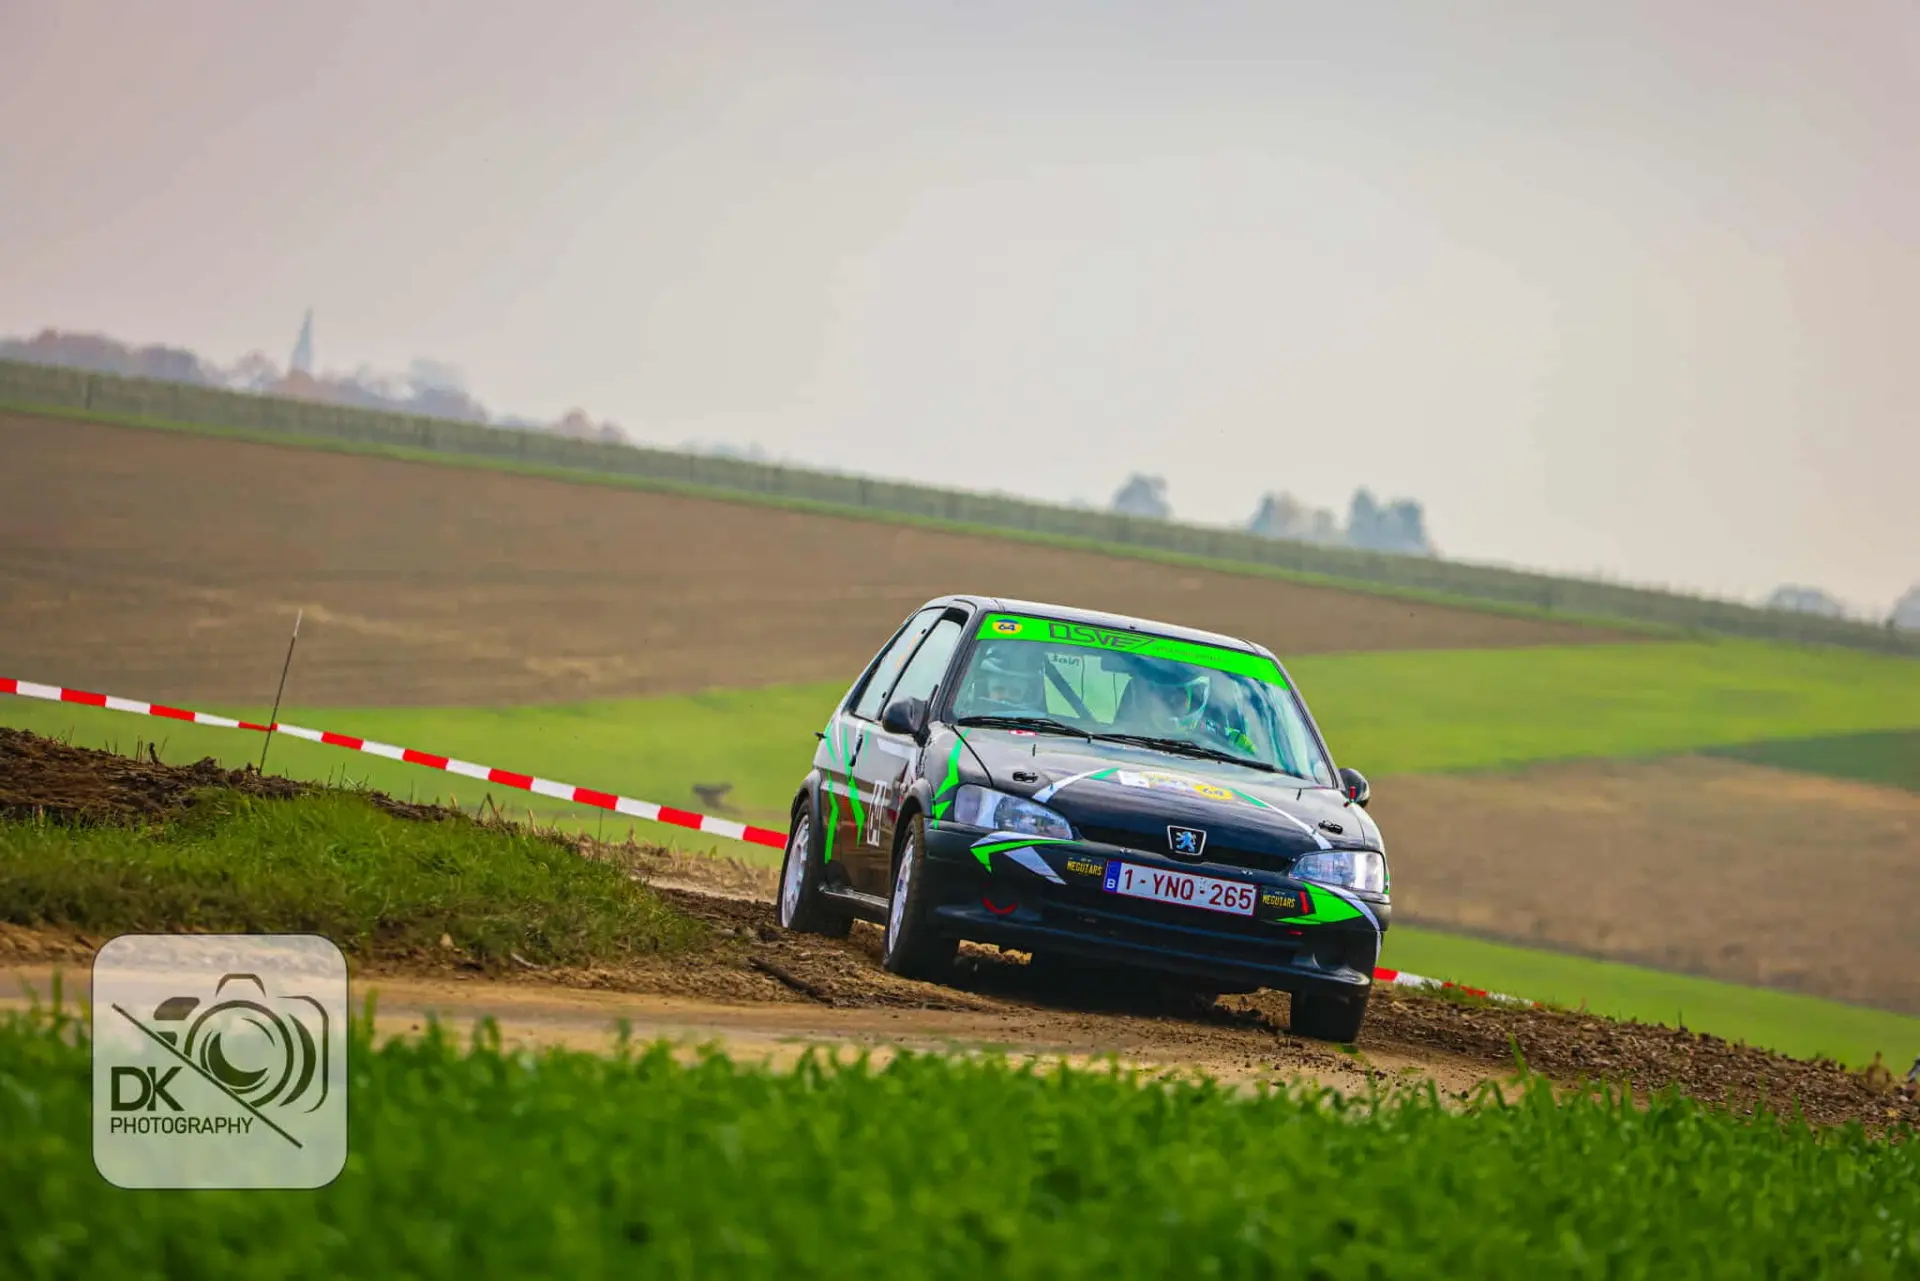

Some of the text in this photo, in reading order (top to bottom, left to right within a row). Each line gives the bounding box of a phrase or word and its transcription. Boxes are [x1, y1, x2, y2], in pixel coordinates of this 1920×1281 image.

[997, 623, 1016, 632] 64
[1067, 860, 1103, 877] MEGUIARS
[1106, 878, 1116, 889] B
[1262, 894, 1297, 909] MEGUIARS
